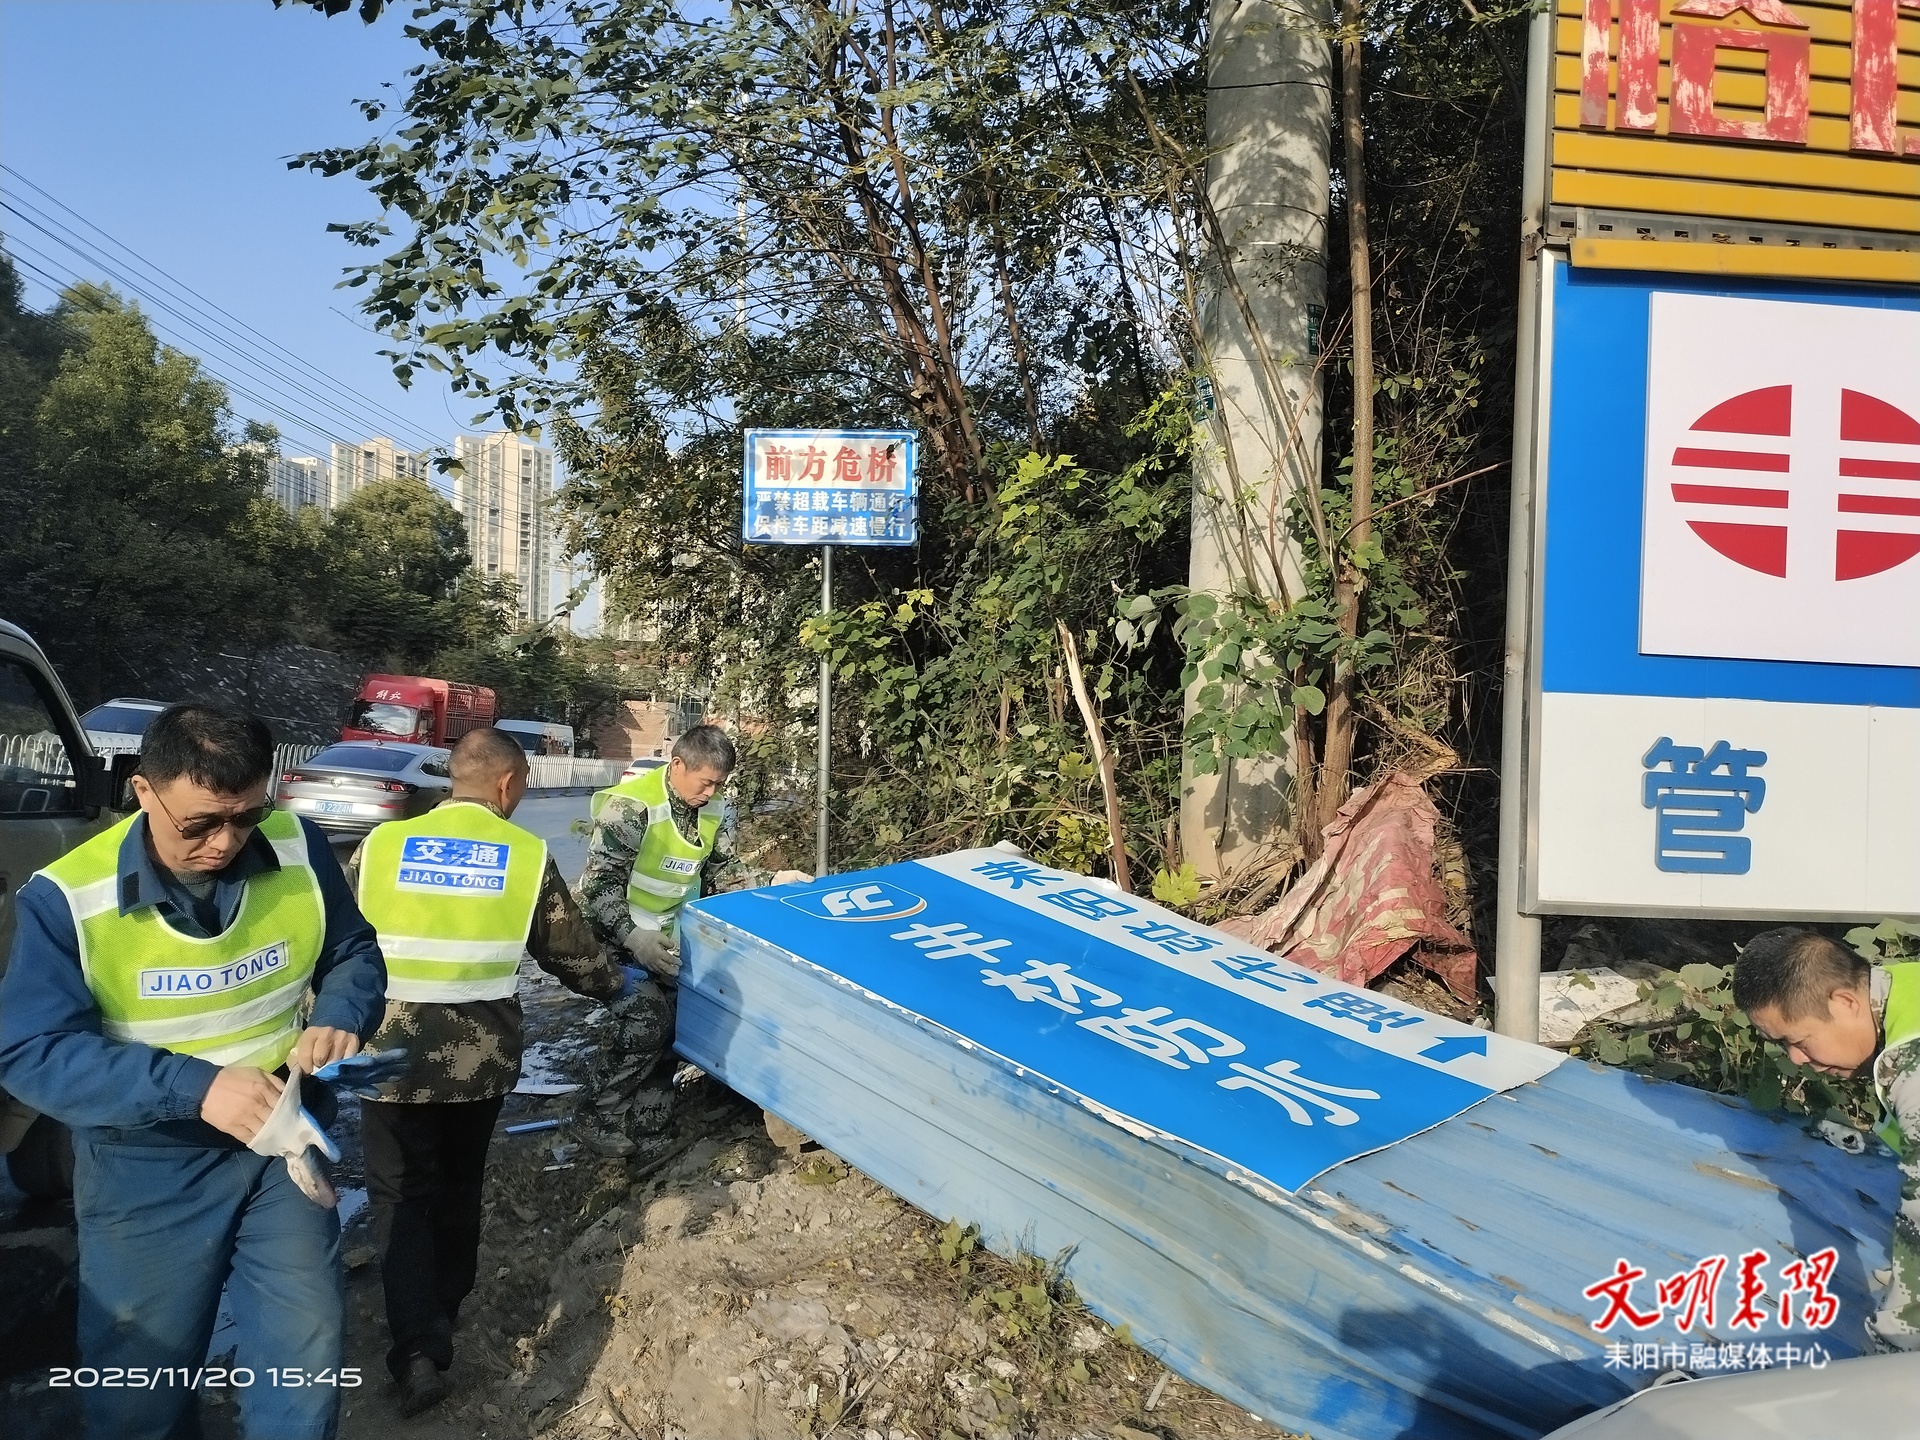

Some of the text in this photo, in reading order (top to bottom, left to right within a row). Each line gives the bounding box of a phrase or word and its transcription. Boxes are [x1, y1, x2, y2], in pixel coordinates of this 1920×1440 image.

[764, 445, 897, 482] 前方危桥
[754, 490, 906, 513] 严禁超载车辆通行
[754, 514, 906, 537] 保持车距减速慢行
[1641, 736, 1768, 875] 管
[413, 839, 500, 867] 交通
[665, 860, 693, 872] JIAO
[403, 870, 500, 888] JIAO TONG
[970, 859, 1425, 1034] 耒阳总代理
[150, 949, 279, 992] JIAO TONG
[889, 922, 1381, 1127] 丰材防水
